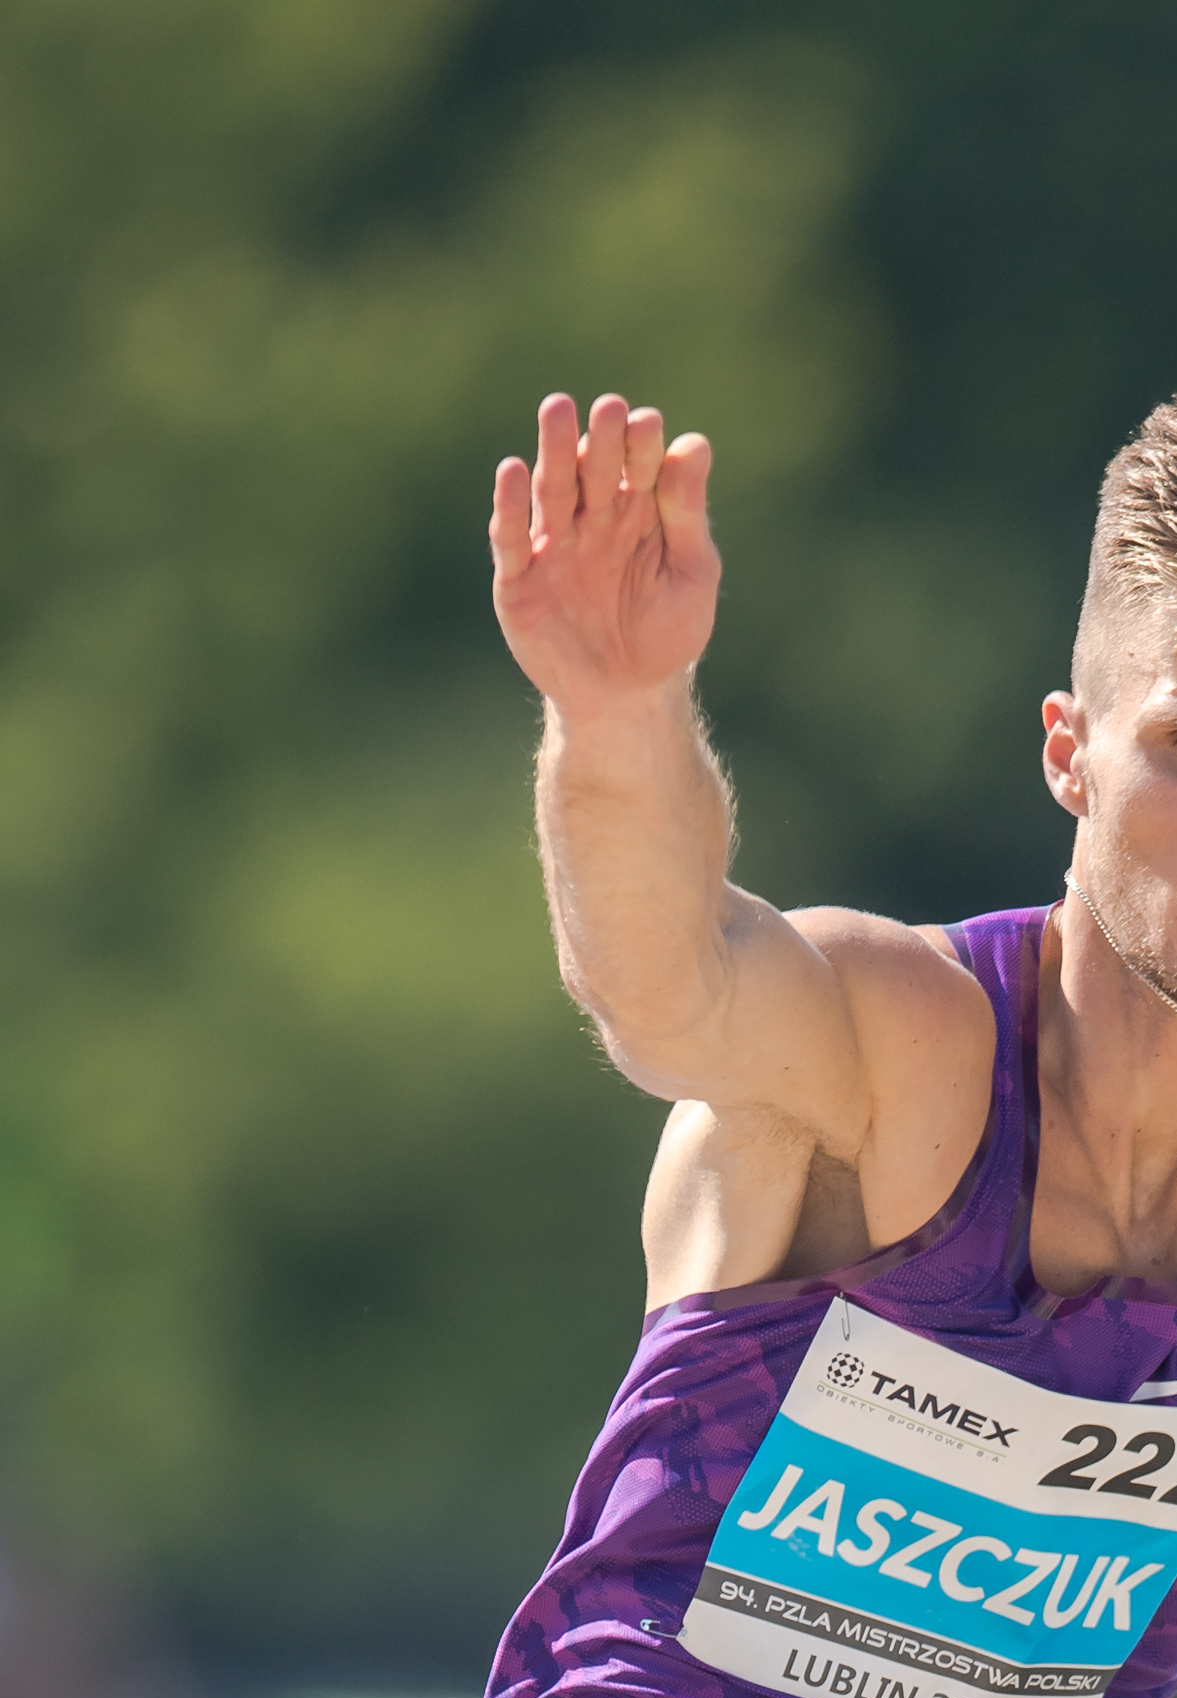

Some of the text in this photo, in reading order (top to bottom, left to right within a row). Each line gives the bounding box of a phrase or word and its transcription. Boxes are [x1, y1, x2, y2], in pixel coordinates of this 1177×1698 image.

[816, 1384, 876, 1413] OBIEKTY
[887, 1414, 964, 1450] SPORTOWE
[871, 1371, 1019, 1448] TAMEX
[736, 1464, 1165, 1631] JASZCZUK
[720, 1581, 1101, 1690] 94. PZLA MISTRZOSTWA POLSKI
